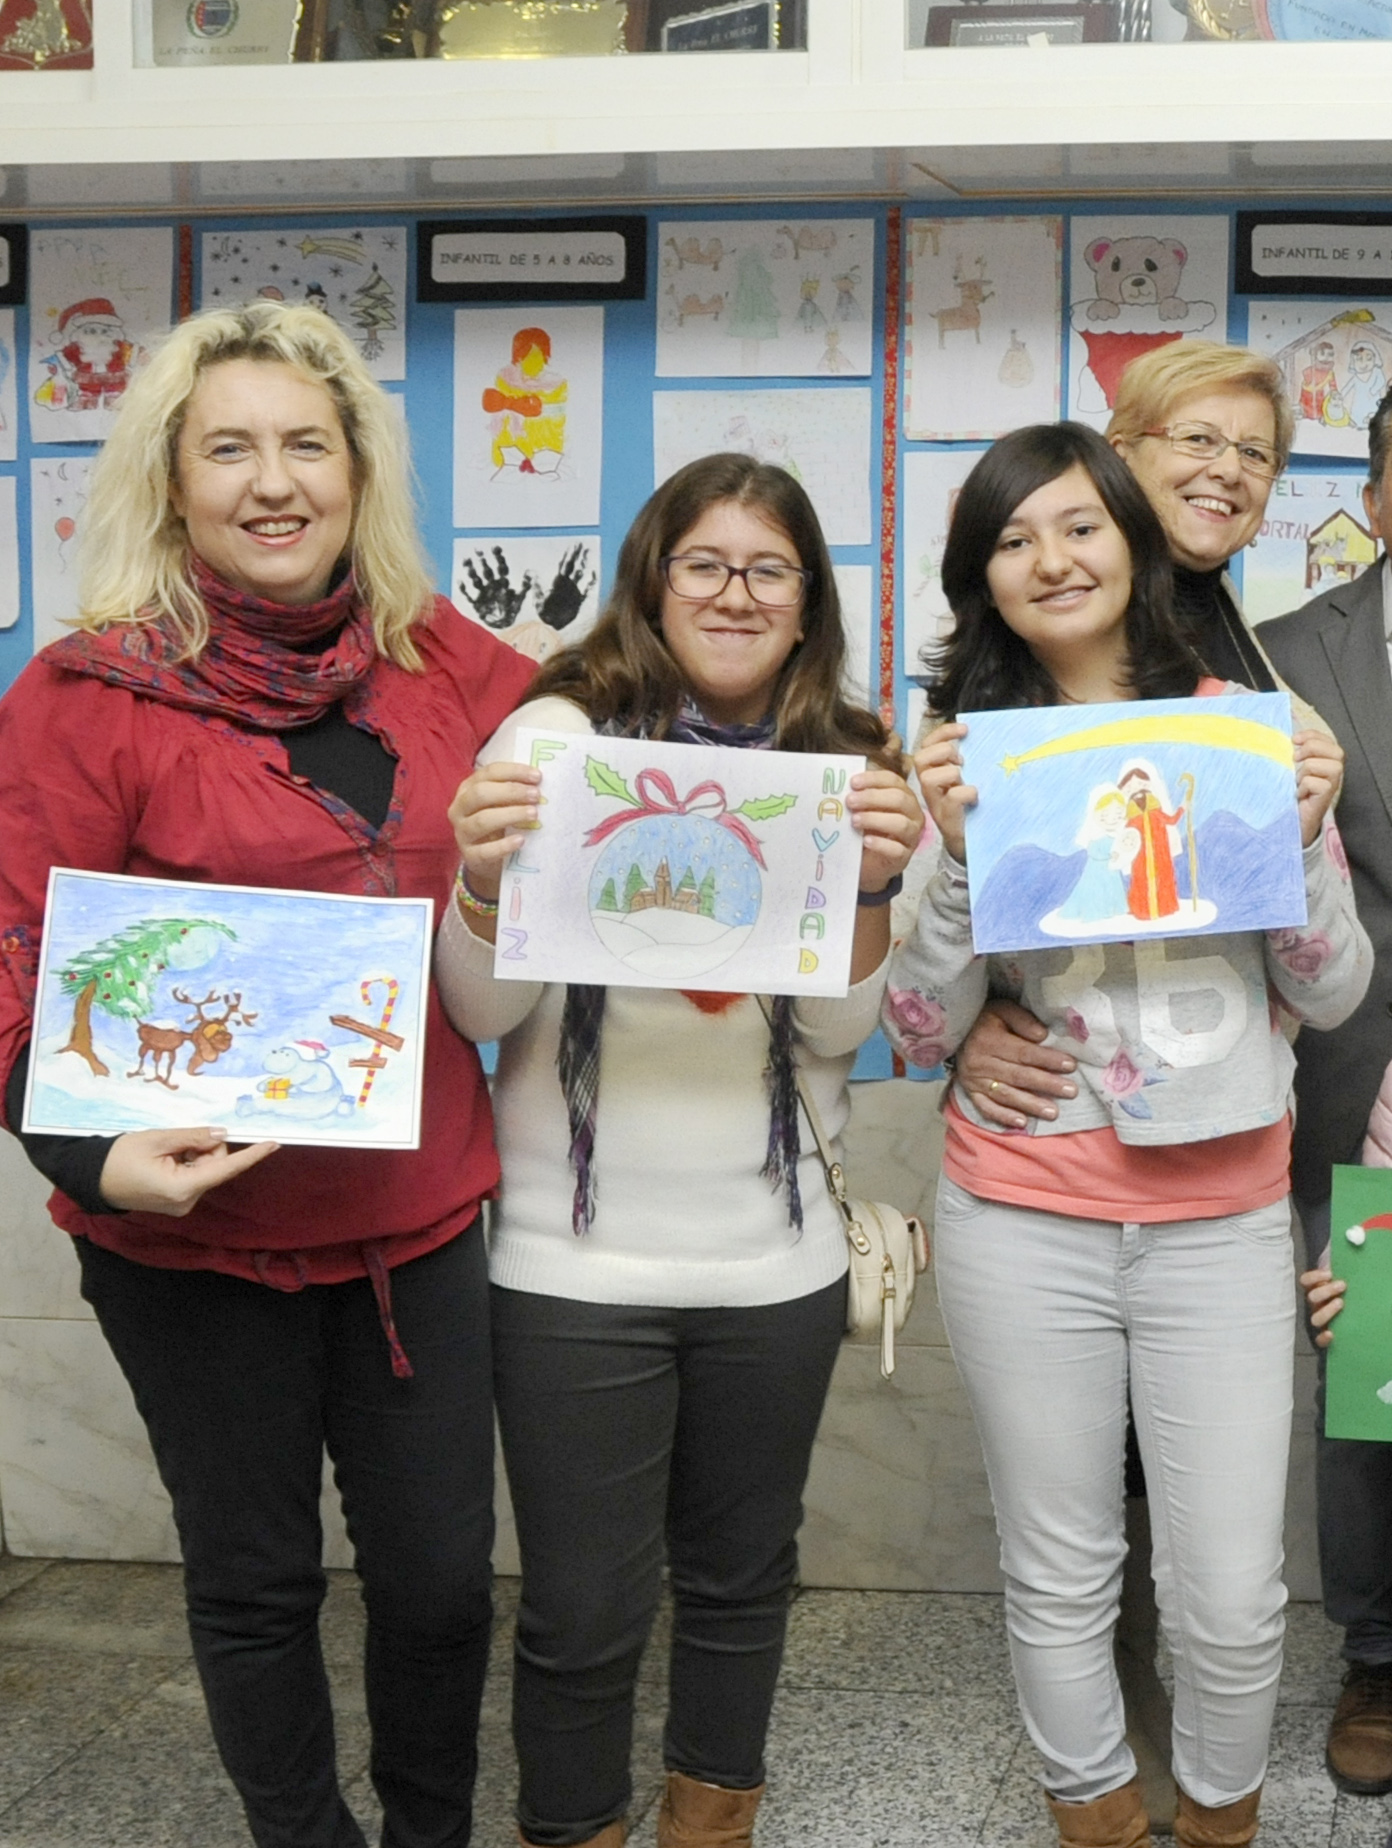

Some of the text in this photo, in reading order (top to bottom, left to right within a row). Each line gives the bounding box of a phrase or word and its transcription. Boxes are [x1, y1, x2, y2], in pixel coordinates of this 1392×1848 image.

[440, 252, 614, 266] INFANTIL DE 5 A 8 AÑOS
[1261, 247, 1328, 260] INFANTIL
[1333, 248, 1349, 260] DE
[1357, 248, 1365, 260] 9
[1373, 249, 1382, 260] A
[1260, 520, 1310, 540] ORTAL
